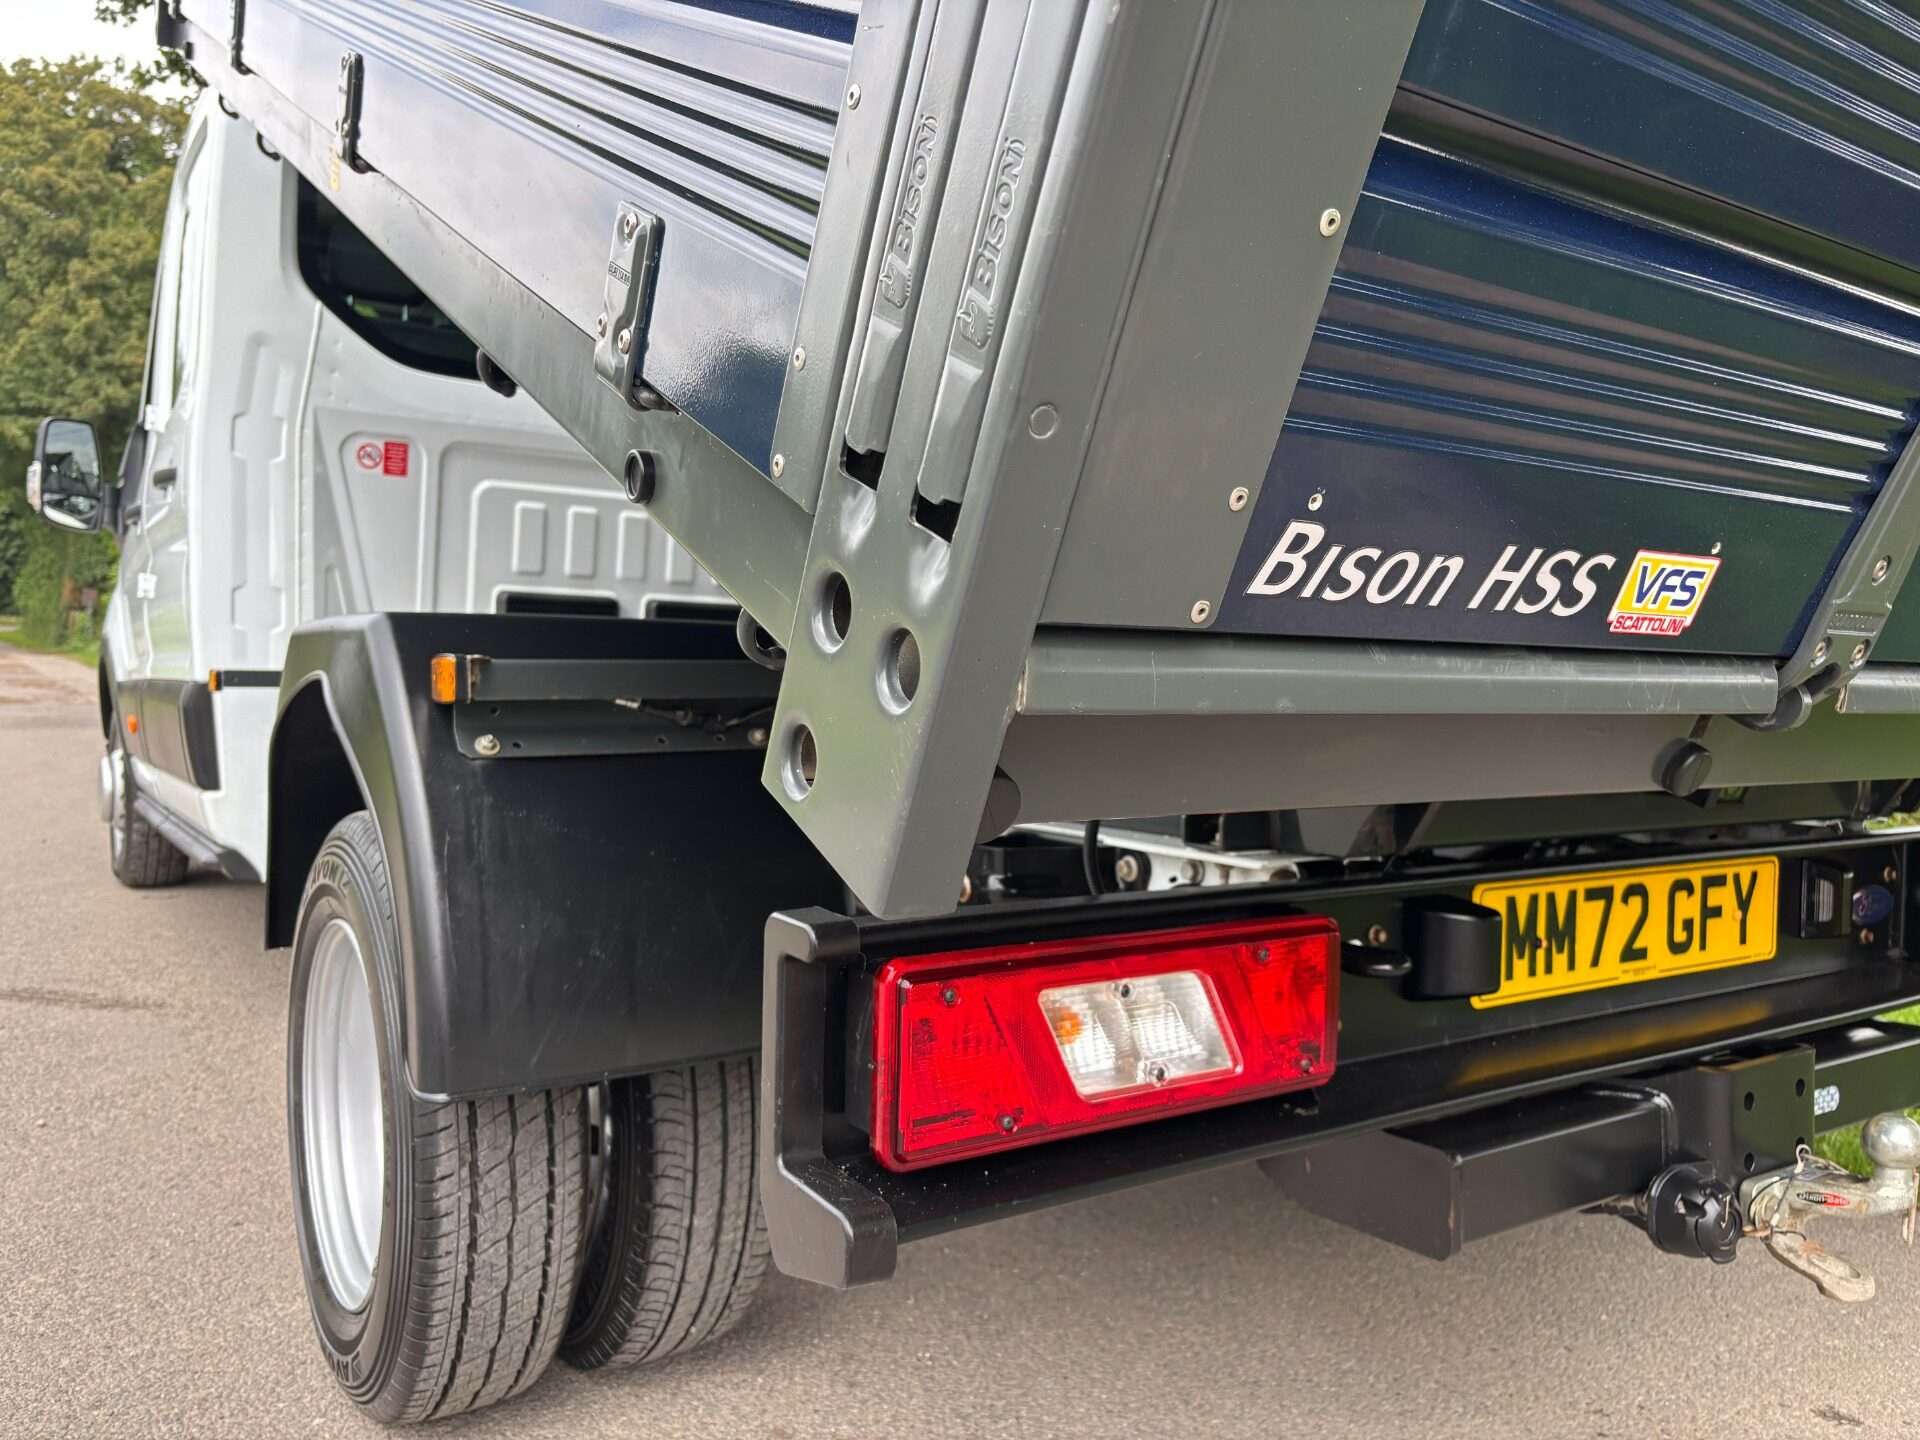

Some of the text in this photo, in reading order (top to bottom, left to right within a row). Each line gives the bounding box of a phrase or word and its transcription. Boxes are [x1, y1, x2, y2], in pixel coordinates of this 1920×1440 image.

[1466, 545, 1617, 617] HSS
[1635, 565, 1706, 607] VFS
[1614, 615, 1685, 633] SCATTOLINI
[1505, 870, 1758, 981] MM72 GFY
